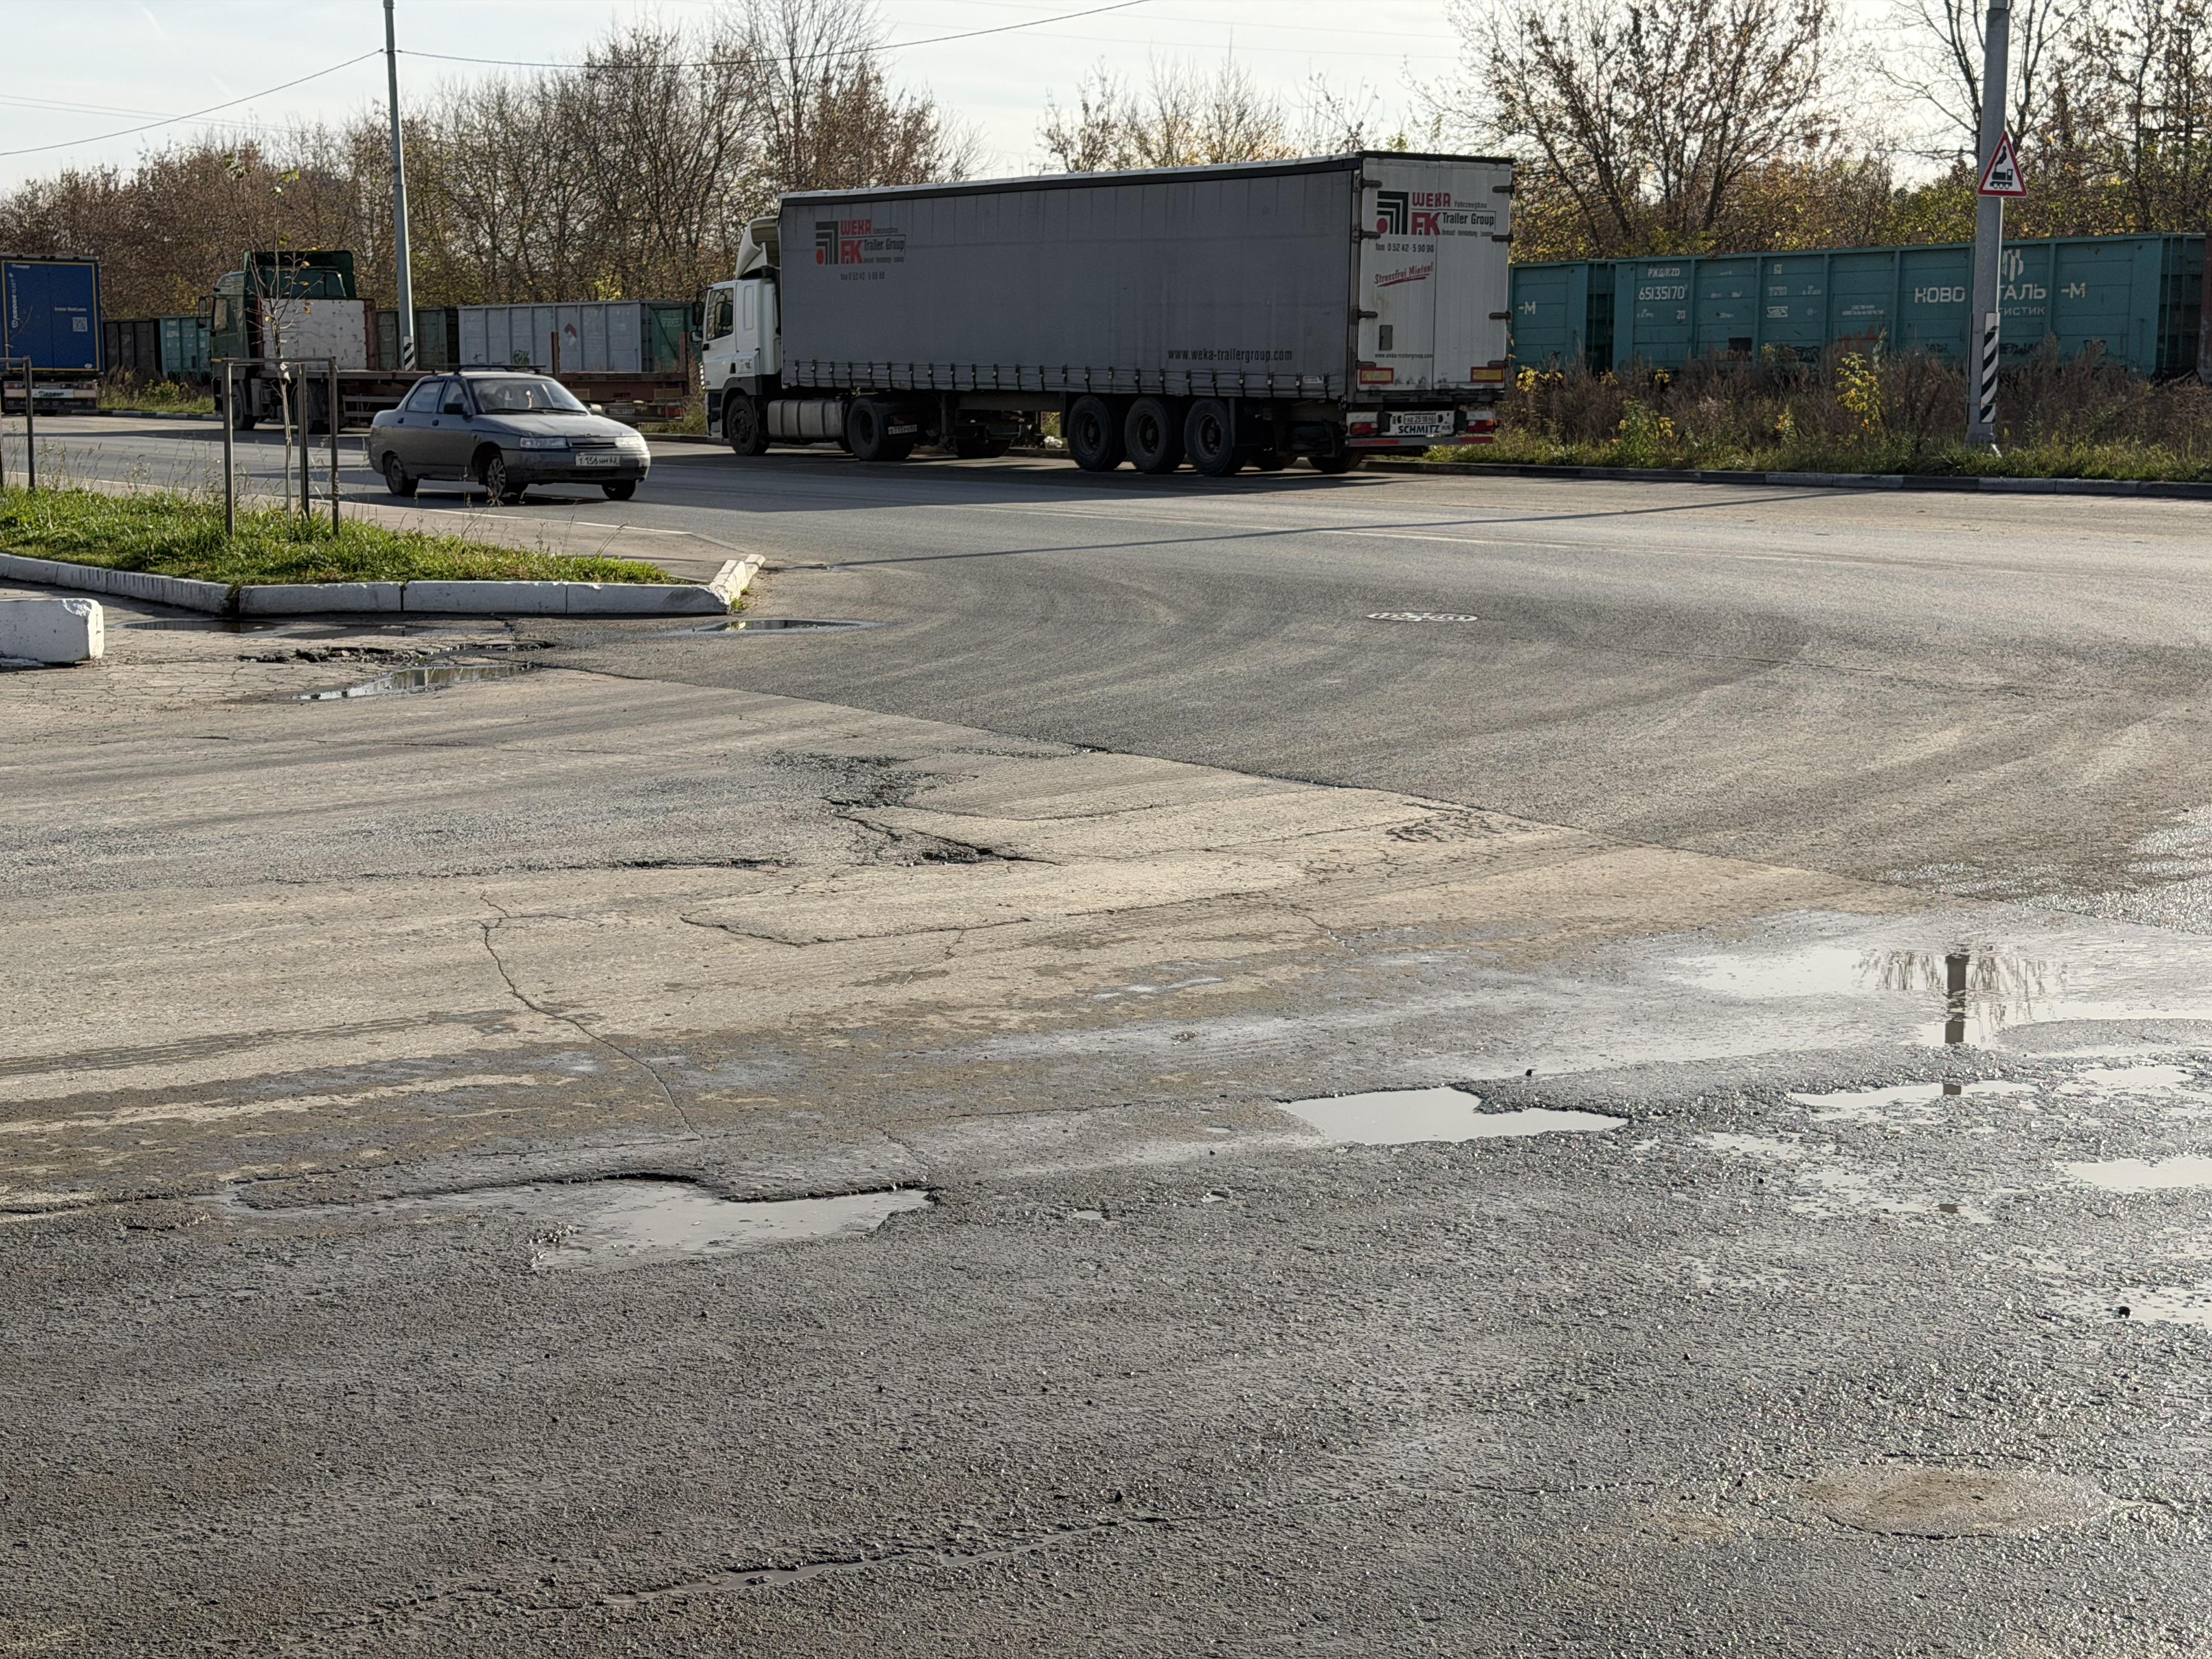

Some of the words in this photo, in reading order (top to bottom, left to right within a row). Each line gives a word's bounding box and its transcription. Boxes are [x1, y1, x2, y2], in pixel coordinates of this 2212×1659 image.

[1412, 192, 1451, 207] WEKA
[840, 219, 872, 235] WEKA
[1411, 212, 1441, 236] FK
[1442, 212, 1469, 224] Trailer
[1471, 213, 1494, 227] Group
[840, 240, 864, 264] FK
[864, 239, 884, 251] Trailer
[1639, 285, 1685, 300] 65135170
[1167, 348, 1292, 363] www.weka-trailergroup.com
[1398, 425, 1440, 434] SCHMITZ
